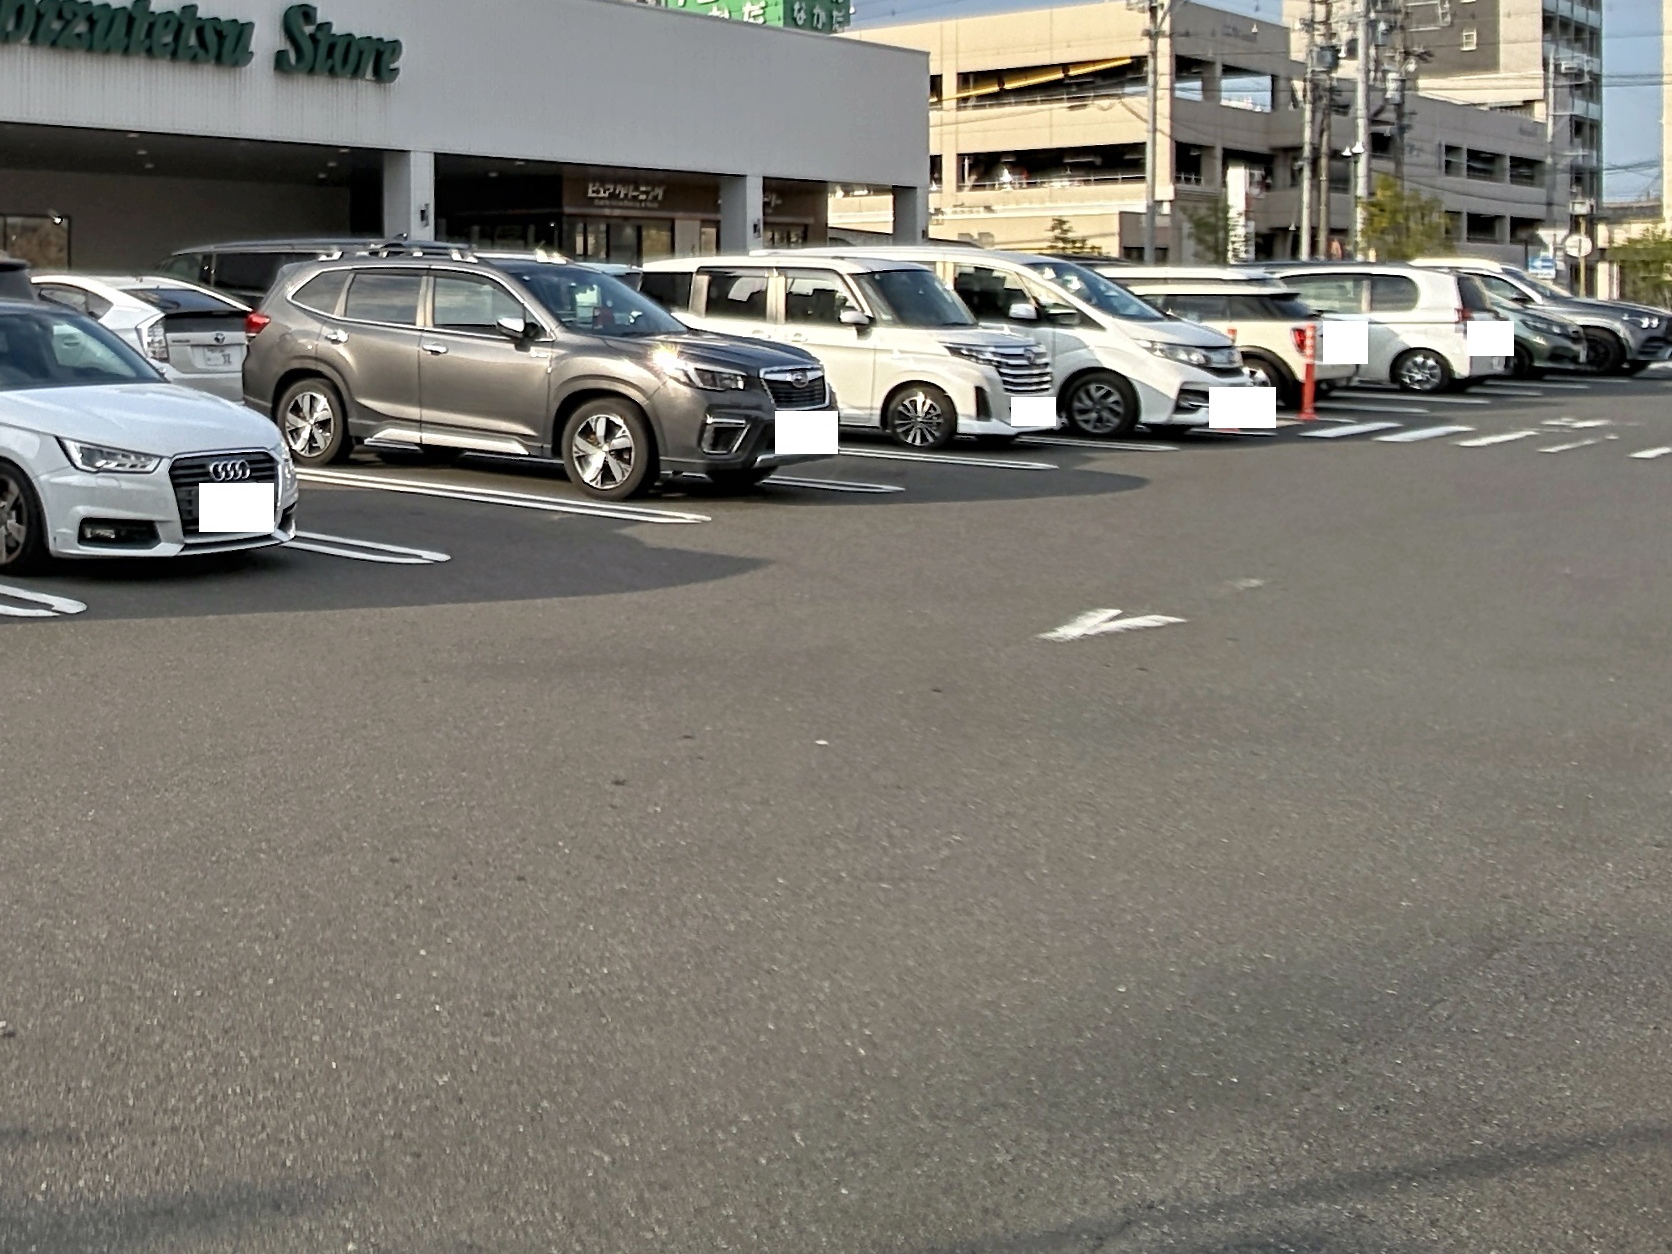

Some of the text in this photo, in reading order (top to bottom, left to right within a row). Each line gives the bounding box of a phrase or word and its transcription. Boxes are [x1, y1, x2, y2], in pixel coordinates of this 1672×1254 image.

[274, 3, 403, 84] Store
[793, 1, 845, 31] なかだ
